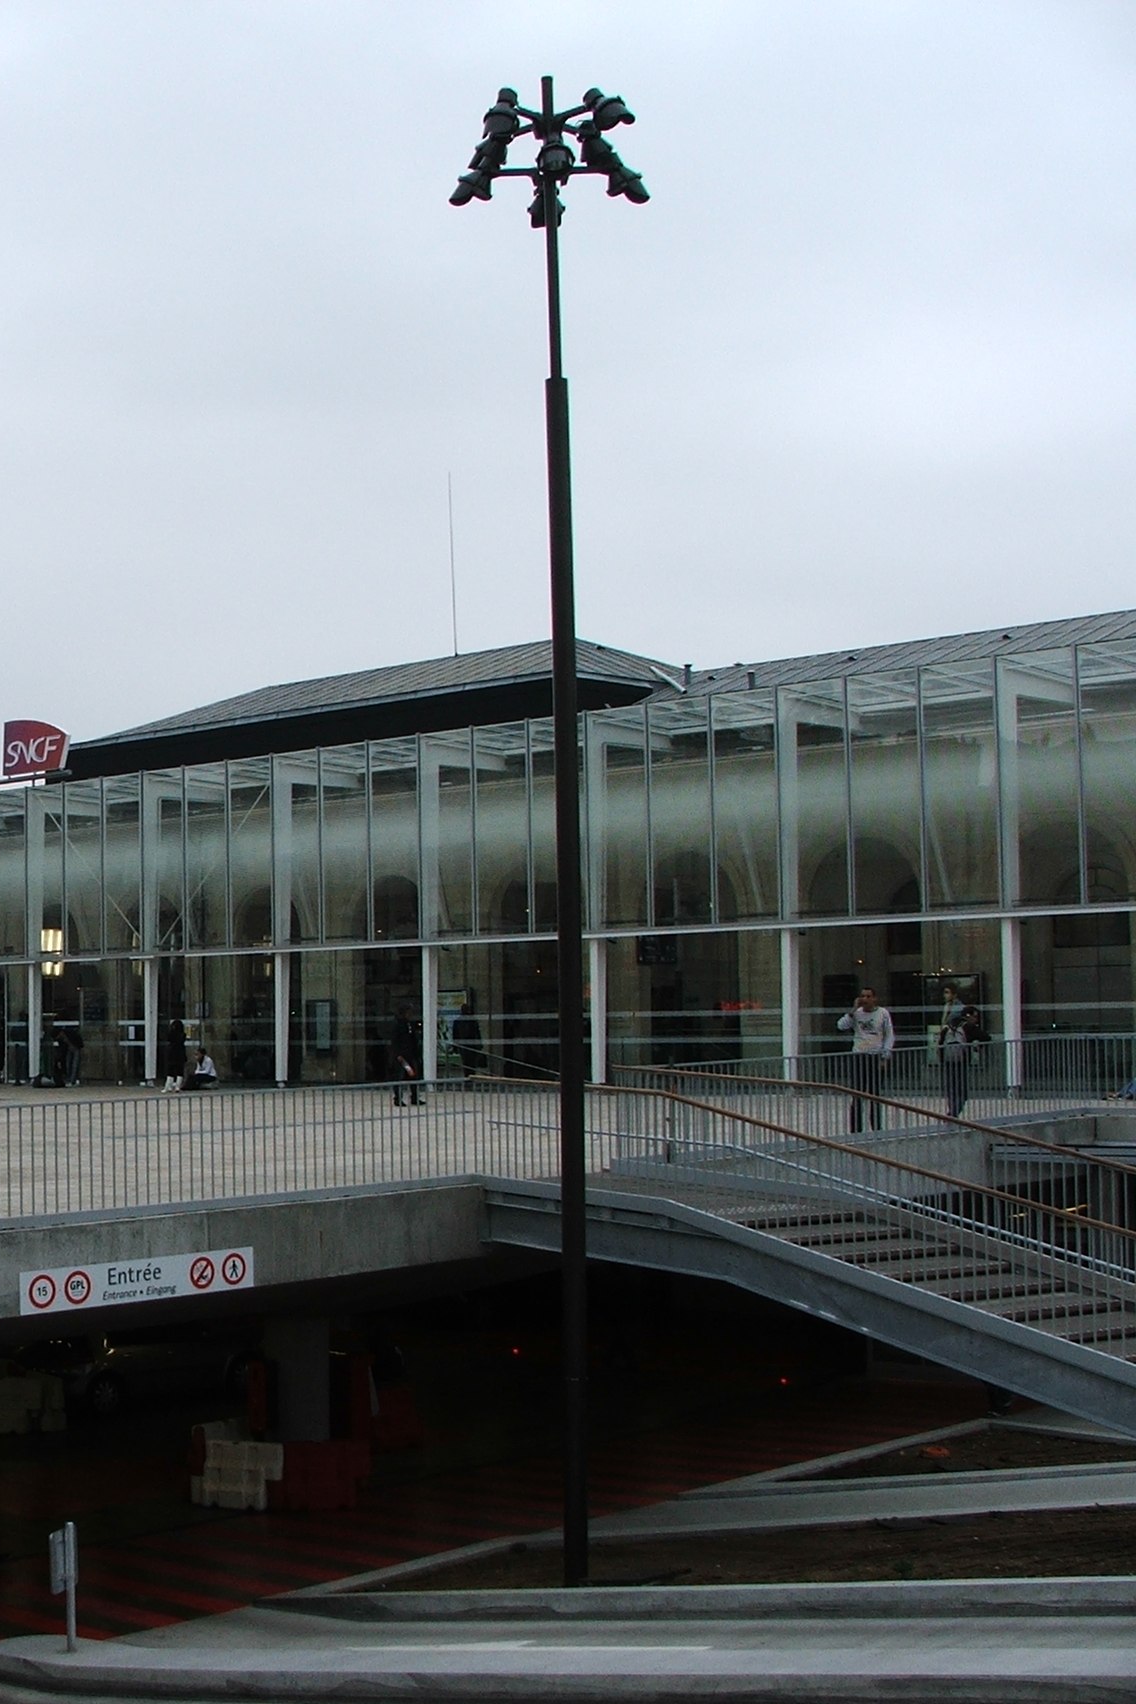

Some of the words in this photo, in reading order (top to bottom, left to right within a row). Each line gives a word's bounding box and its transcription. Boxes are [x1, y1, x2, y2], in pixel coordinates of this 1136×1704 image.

[4, 733, 62, 769] SNCF
[107, 1262, 162, 1286] Entrée
[37, 1287, 48, 1297] 15
[70, 1280, 85, 1290] GPL
[102, 1289, 137, 1301] Entrance
[145, 1285, 176, 1296] Eingang
